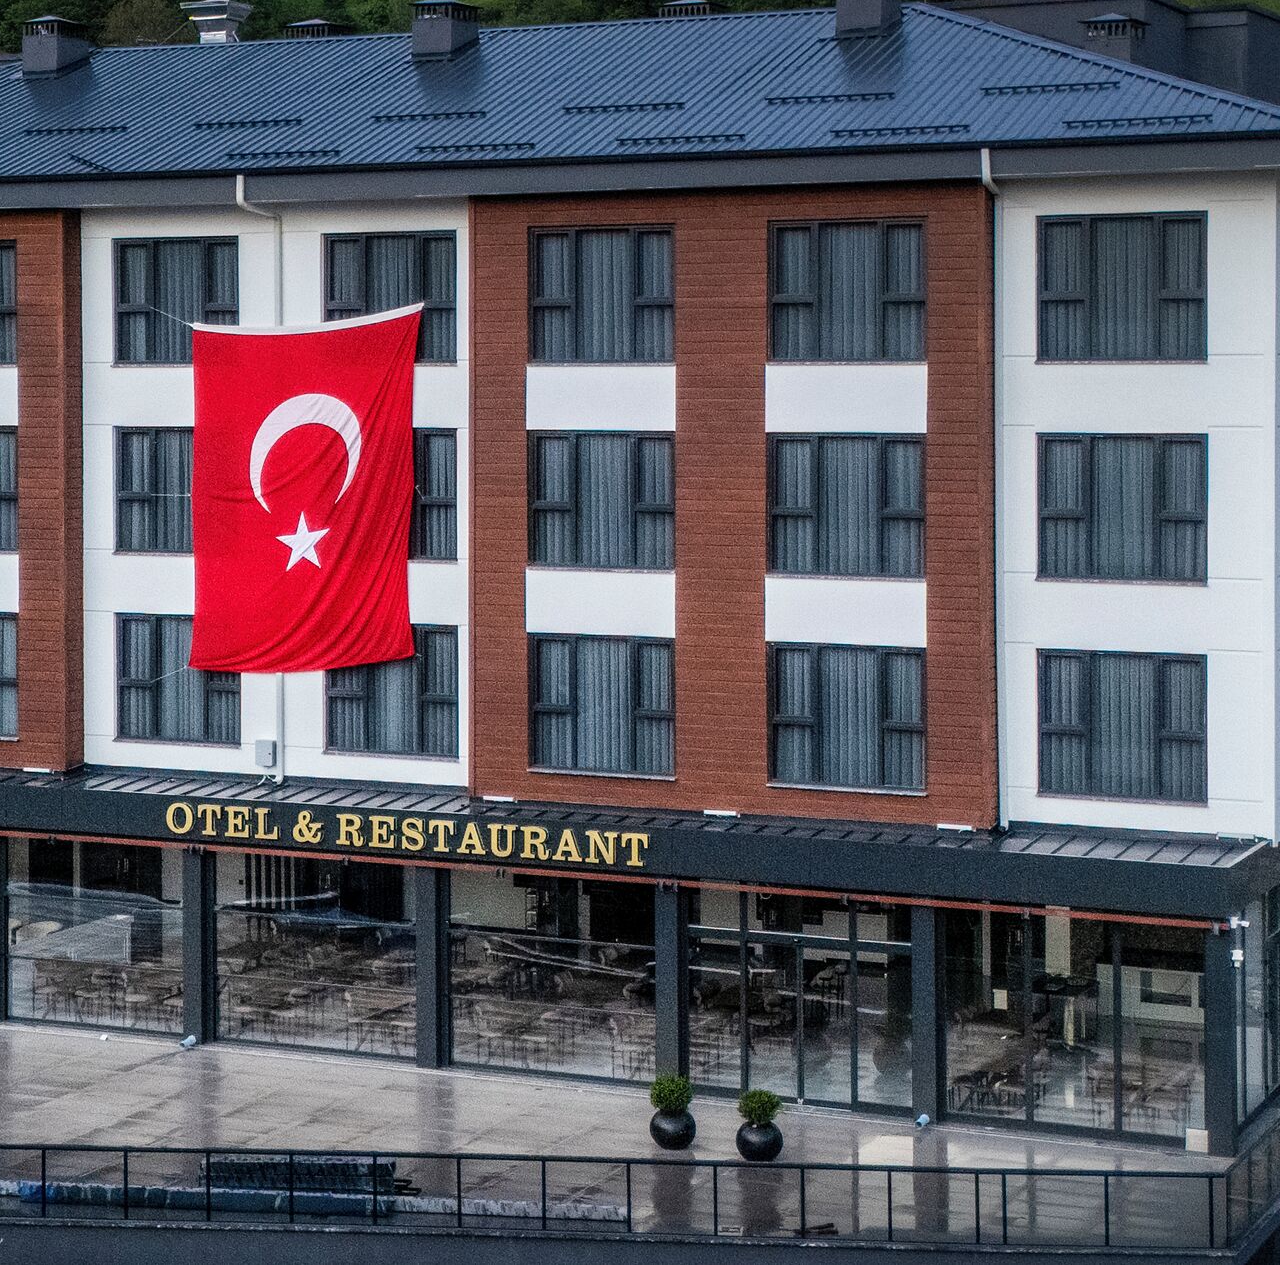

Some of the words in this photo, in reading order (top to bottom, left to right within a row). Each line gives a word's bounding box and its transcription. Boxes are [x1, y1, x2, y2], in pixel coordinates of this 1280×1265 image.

[166, 802, 280, 840] OTEL
[292, 810, 324, 843] &
[336, 813, 650, 867] RESTAURANT
